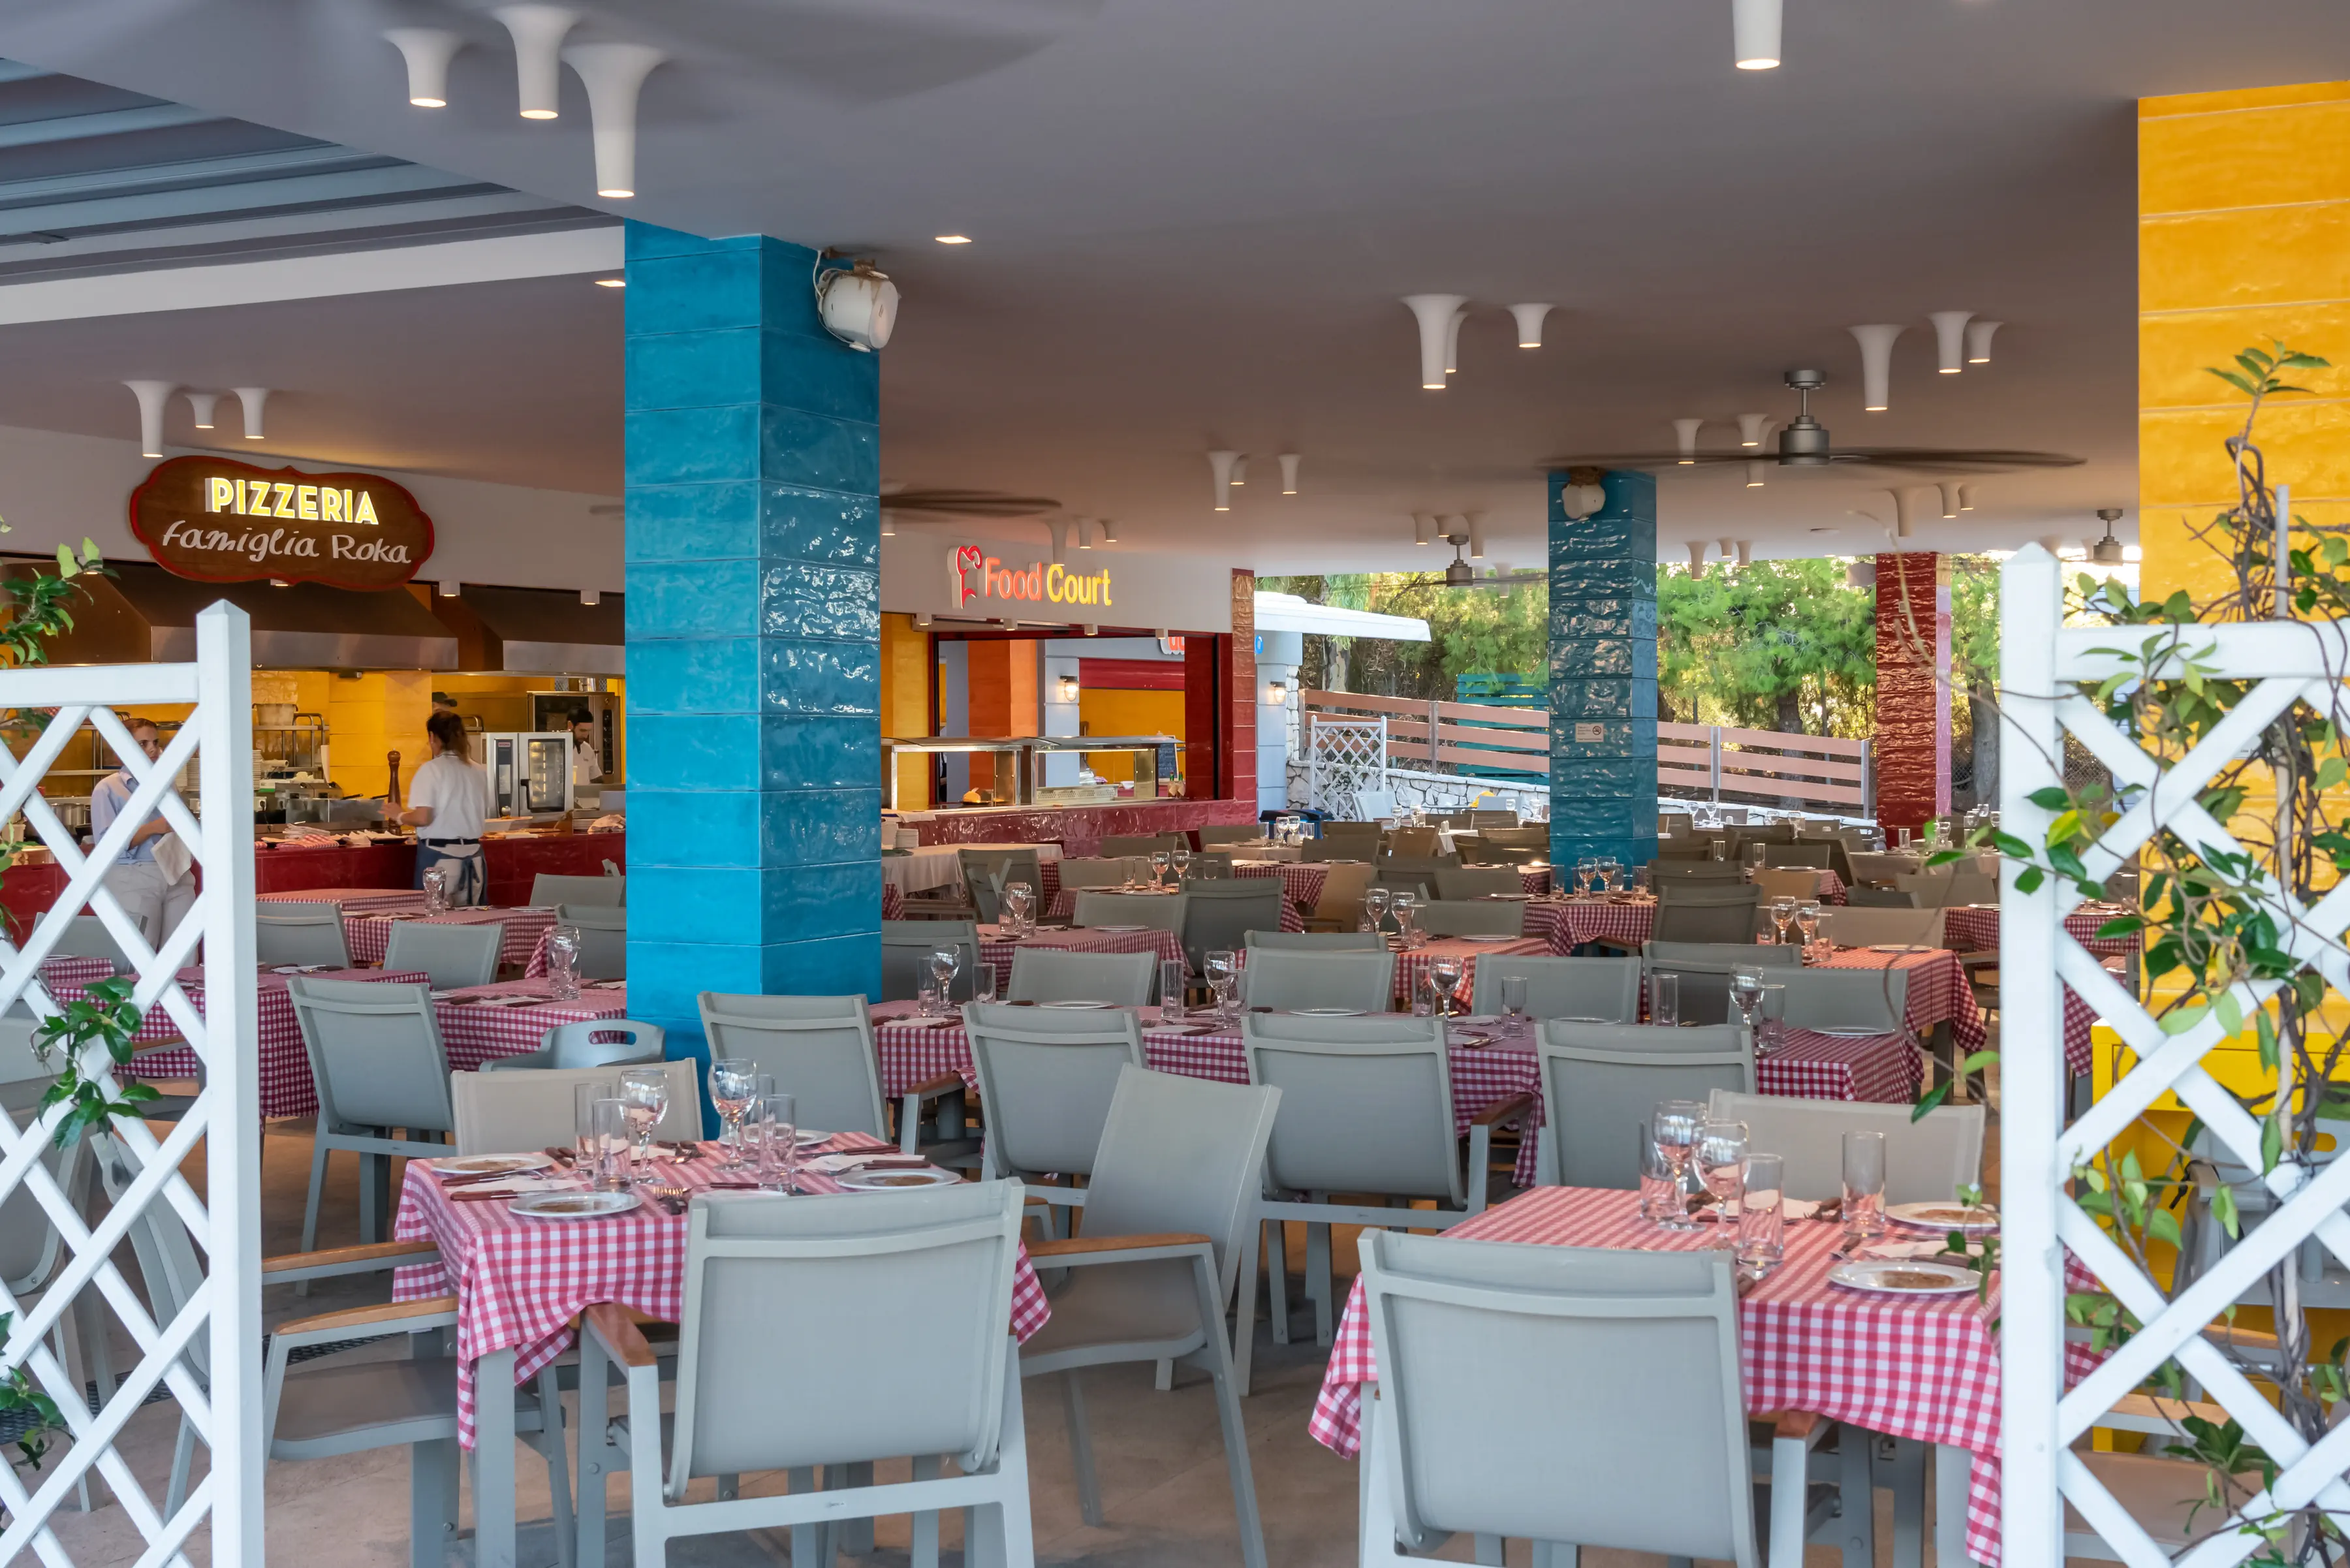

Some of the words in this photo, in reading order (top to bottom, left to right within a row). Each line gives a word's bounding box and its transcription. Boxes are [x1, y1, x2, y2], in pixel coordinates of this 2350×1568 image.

[206, 477, 379, 525] PIZZERIA
[332, 535, 411, 564] Roka
[985, 557, 1042, 601] Food
[1047, 564, 1112, 606] Court
